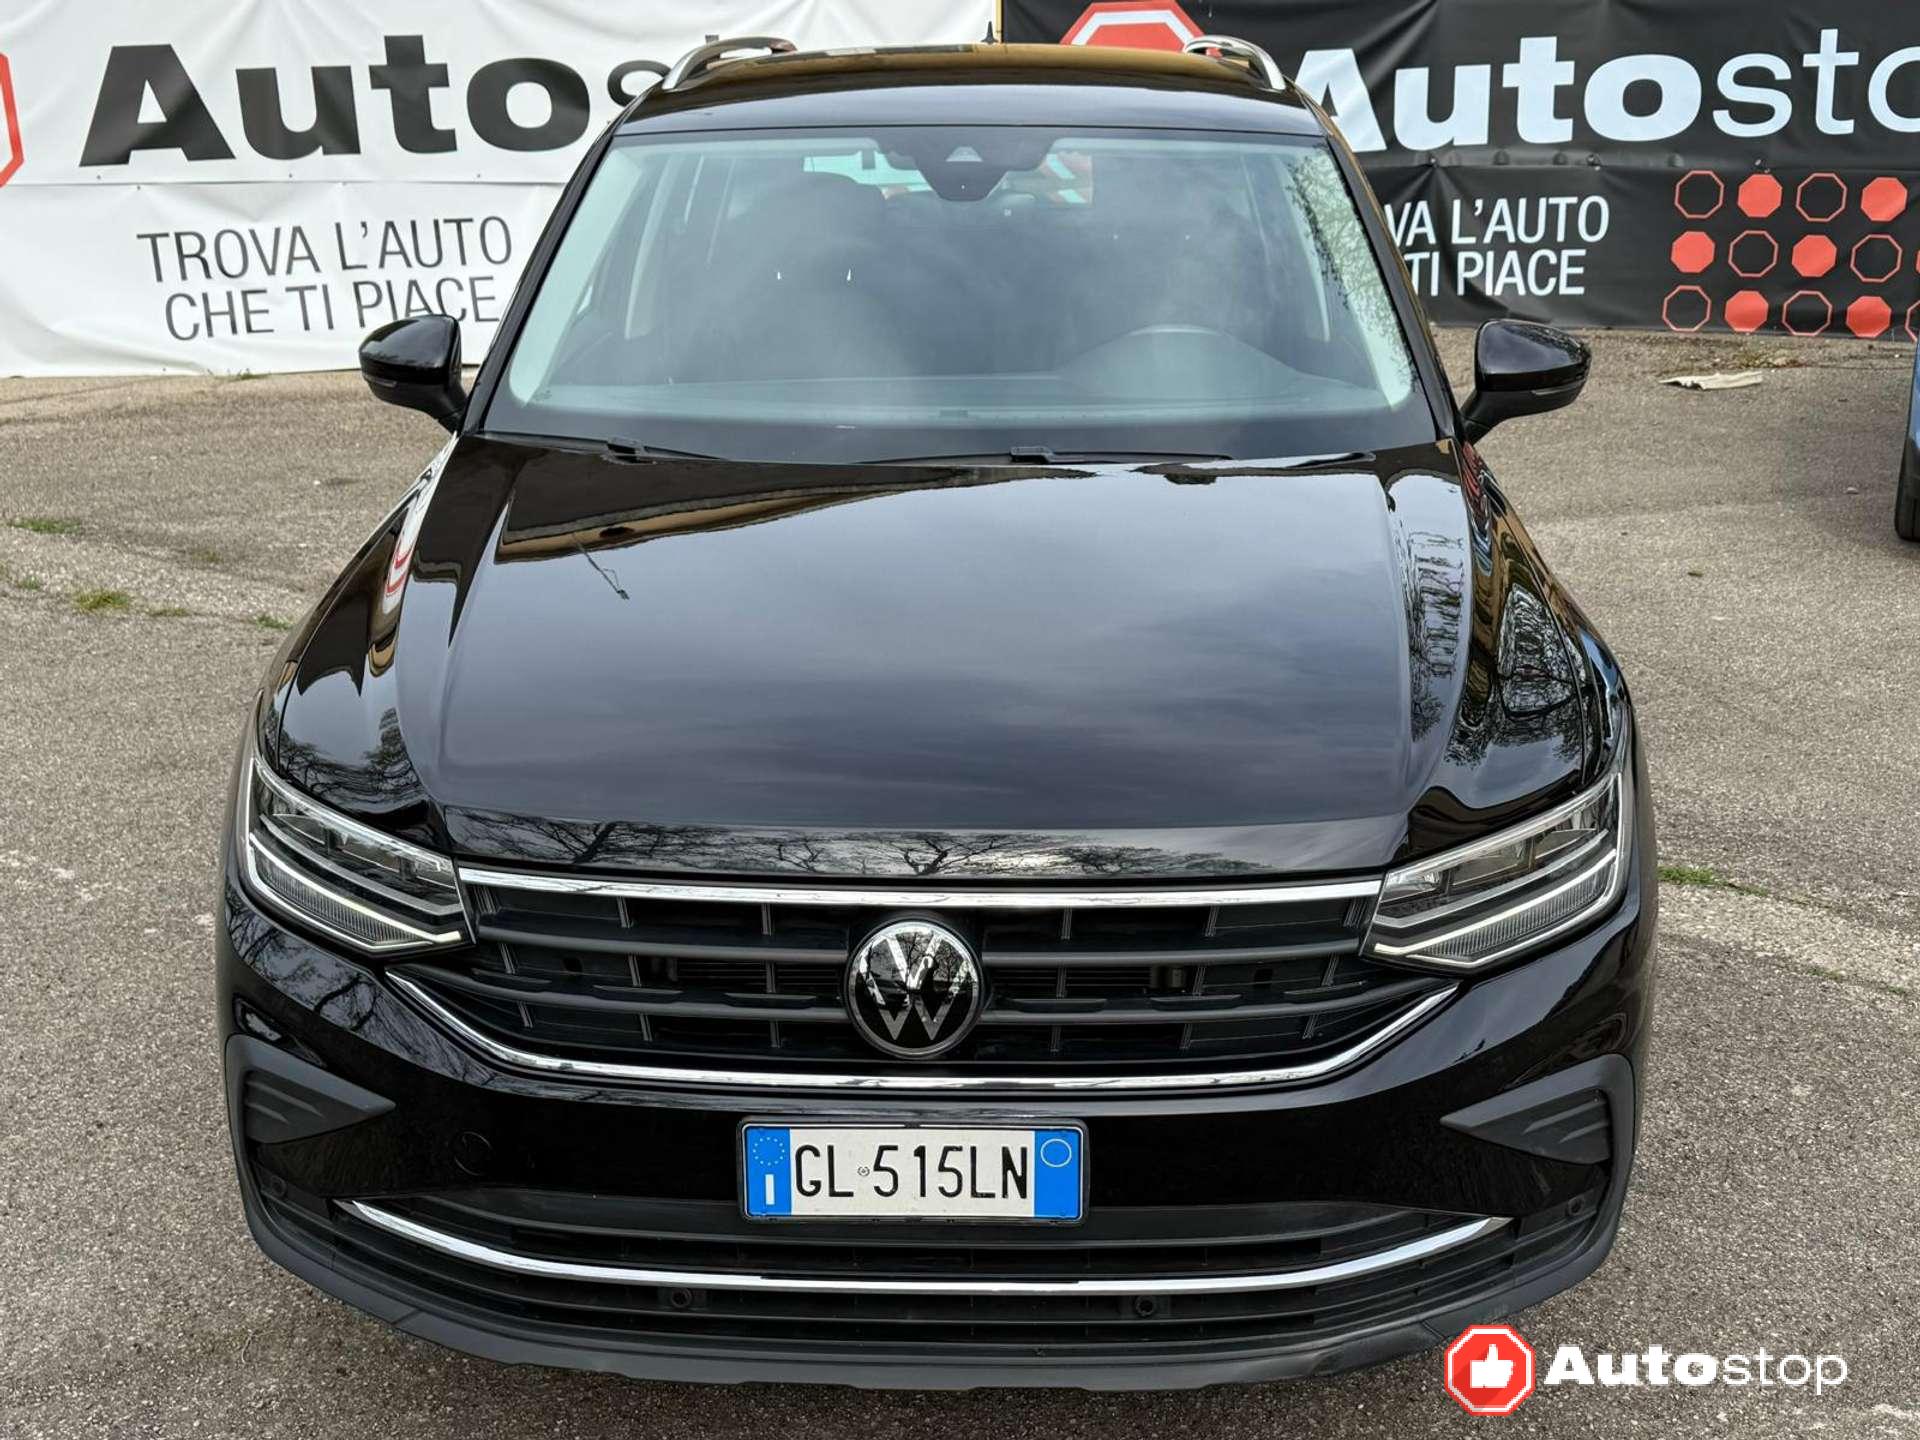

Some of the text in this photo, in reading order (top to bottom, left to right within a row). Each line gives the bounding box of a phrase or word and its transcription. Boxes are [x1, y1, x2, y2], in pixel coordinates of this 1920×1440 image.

[1384, 200, 1436, 247] VA
[137, 224, 321, 283] TROVA
[1456, 249, 1587, 297] PIACE
[165, 275, 501, 341] CHE TI PIACE
